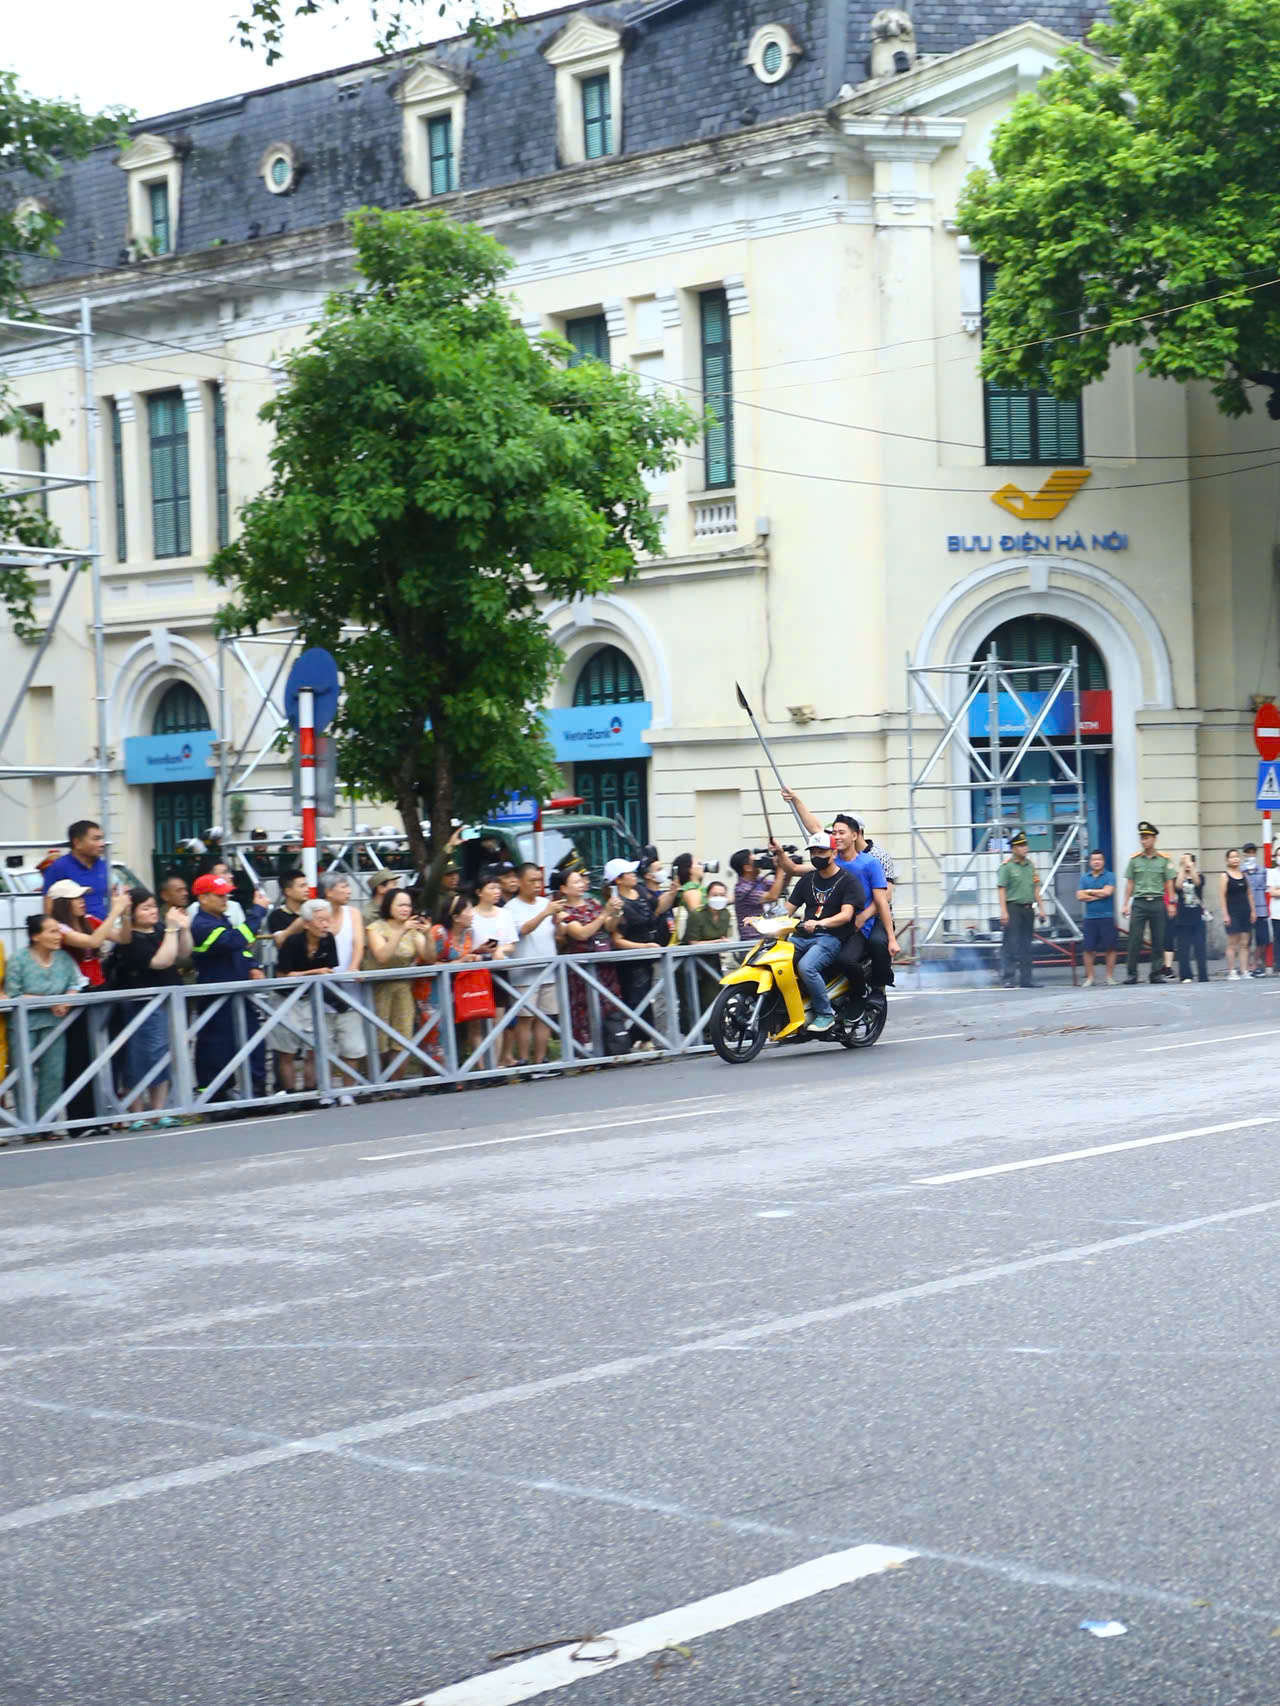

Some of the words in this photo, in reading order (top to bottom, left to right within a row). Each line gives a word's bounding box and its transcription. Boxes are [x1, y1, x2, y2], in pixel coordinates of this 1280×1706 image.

[947, 534, 993, 552] BƯU
[998, 531, 1050, 553] ĐIỆN
[1055, 530, 1087, 552] HÀ
[1091, 530, 1129, 553] NỘI
